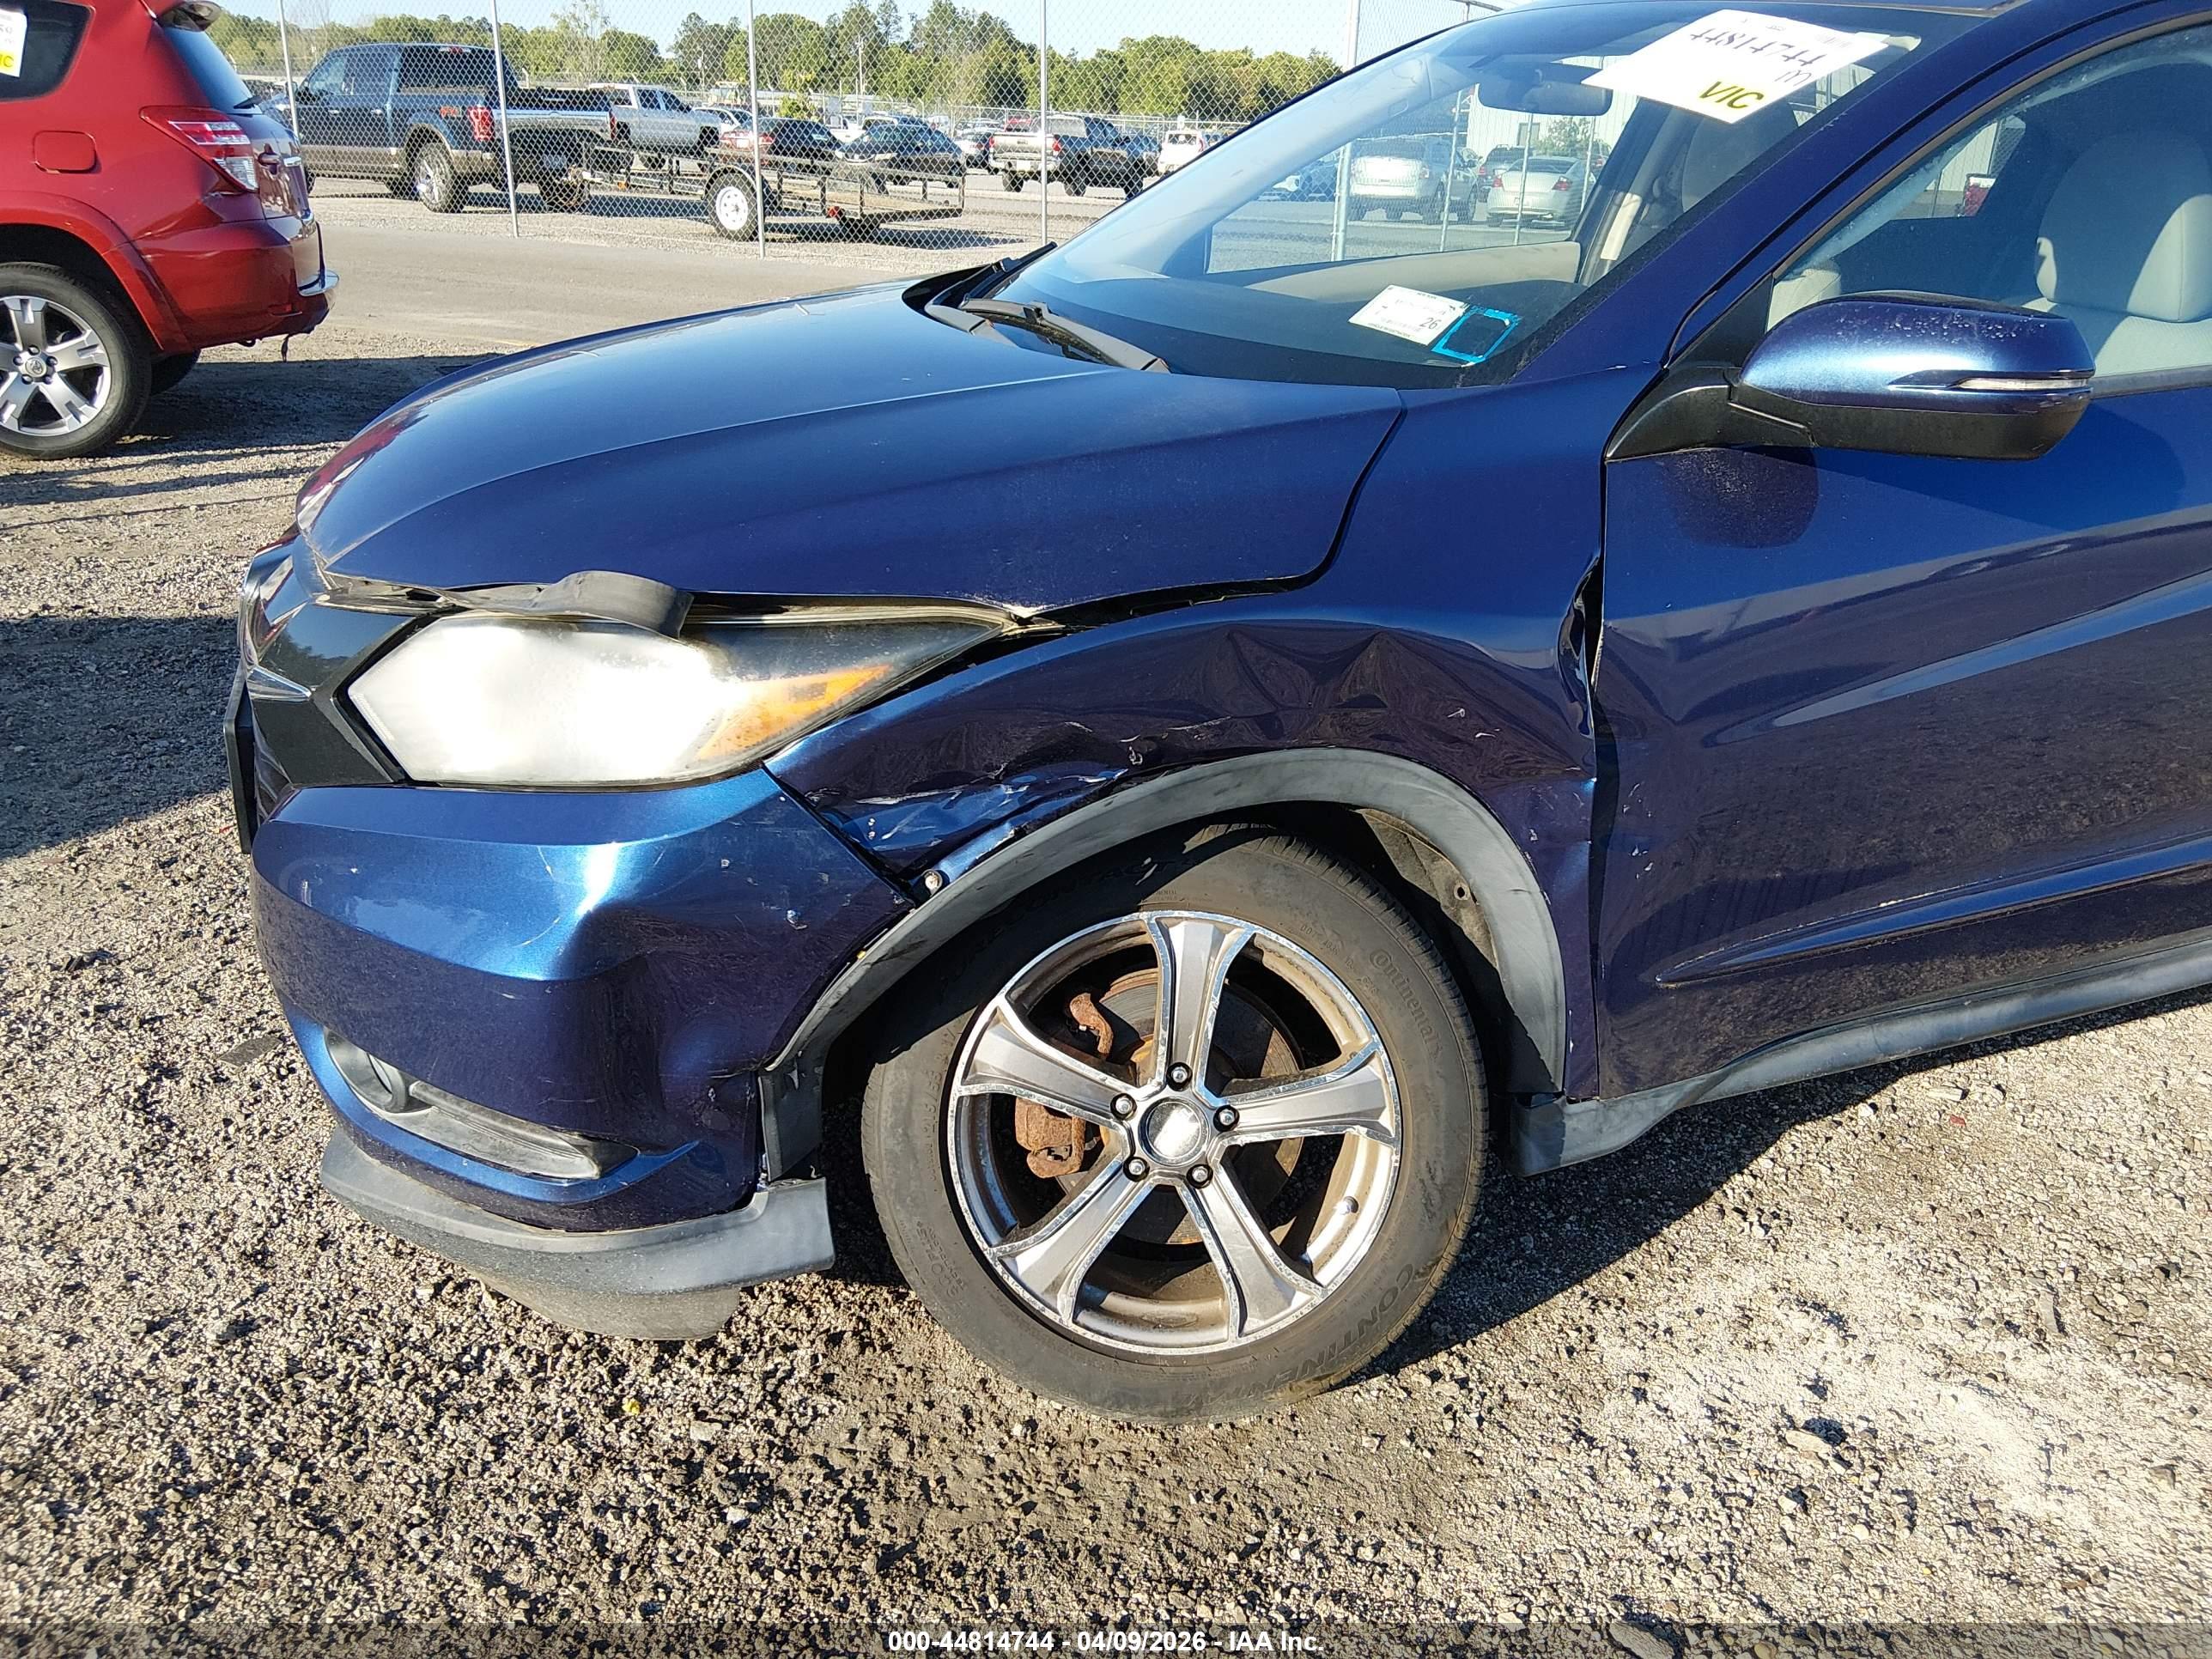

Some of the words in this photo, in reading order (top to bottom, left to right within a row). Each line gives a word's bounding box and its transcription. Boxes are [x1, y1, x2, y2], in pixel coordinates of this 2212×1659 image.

[1690, 28, 1826, 66] 44814744
[1699, 82, 1764, 109] VIC
[1419, 318, 1441, 329] 26
